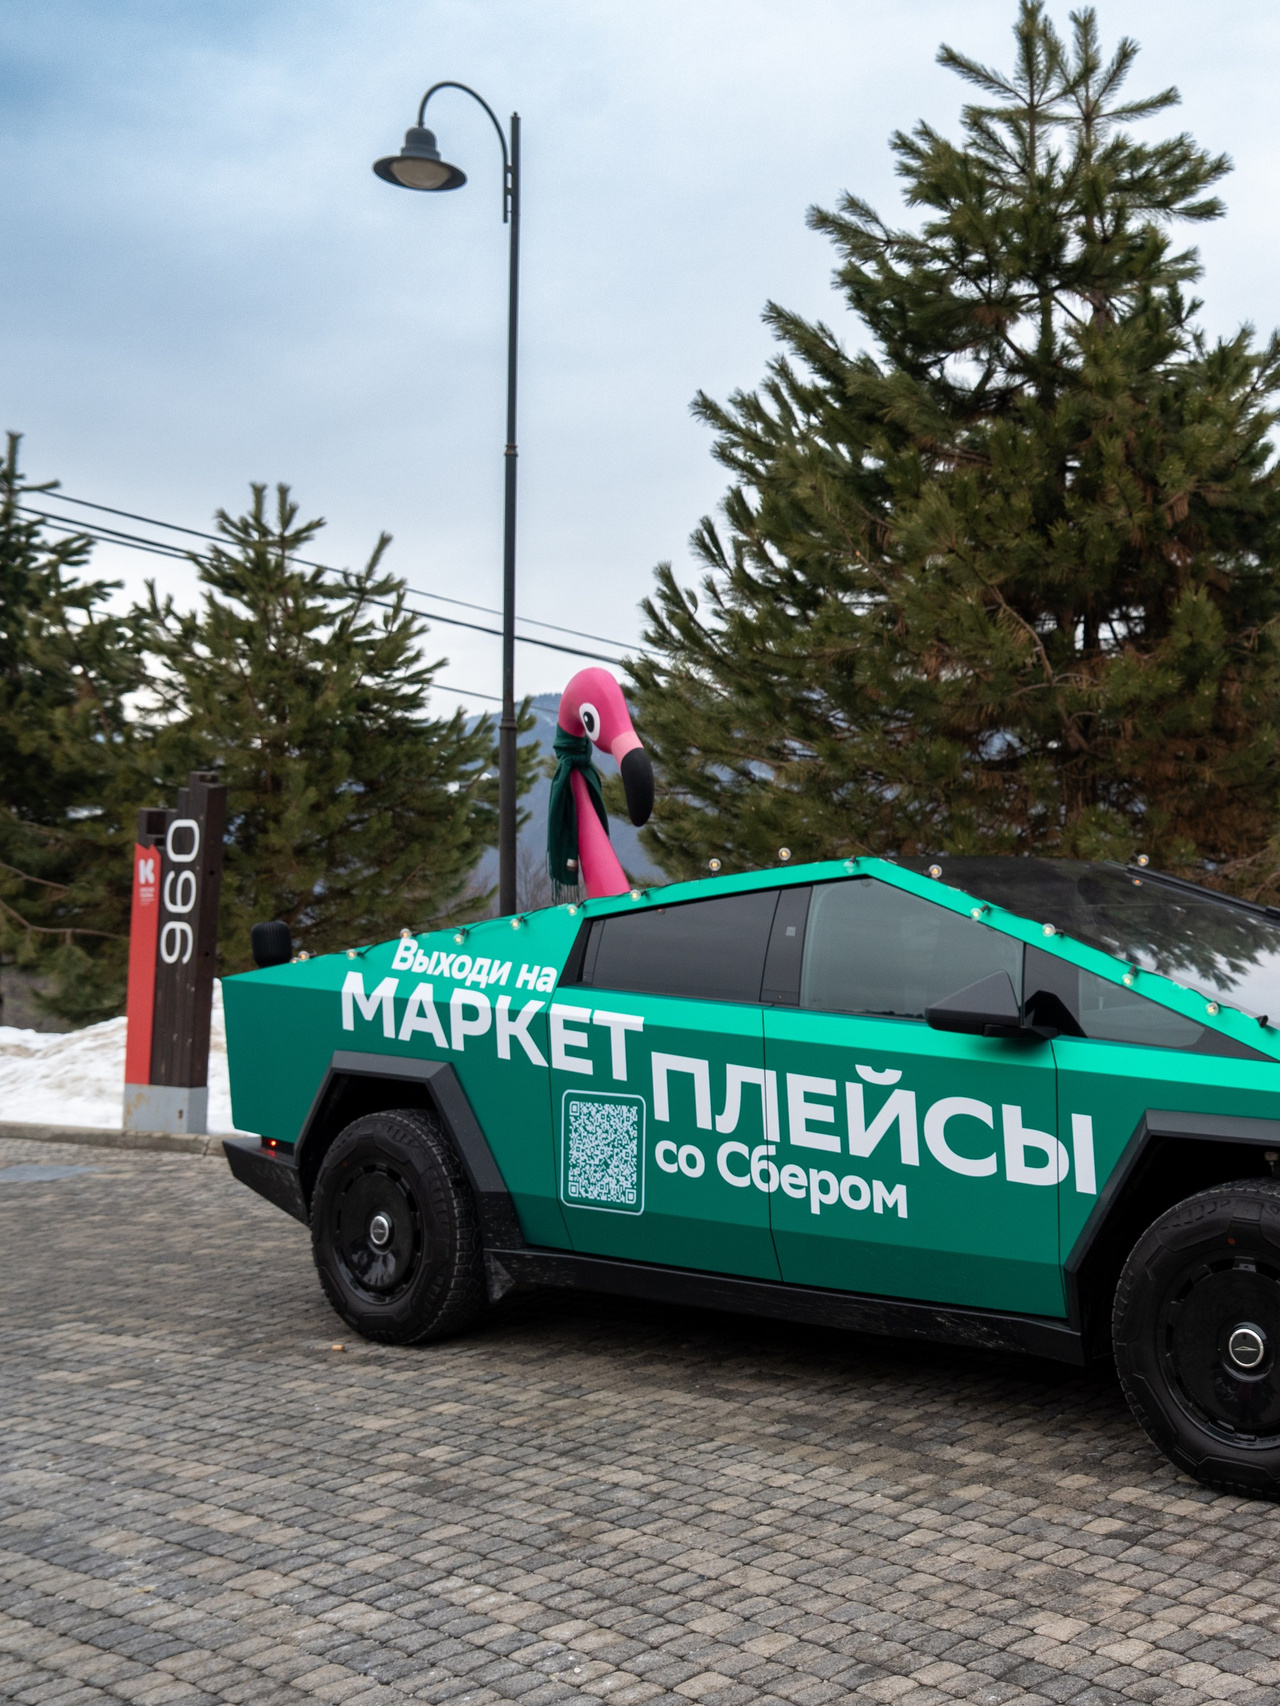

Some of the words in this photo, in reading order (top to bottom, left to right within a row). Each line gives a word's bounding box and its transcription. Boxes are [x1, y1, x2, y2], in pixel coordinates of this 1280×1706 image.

[160, 818, 200, 964] 960
[392, 938, 511, 988] Выходи
[514, 962, 558, 993] на
[340, 971, 645, 1082] МАРКЕТ
[650, 1051, 1098, 1196] ПЛЕЙСЫ
[653, 1138, 706, 1178] со
[716, 1140, 909, 1220] Сбером
